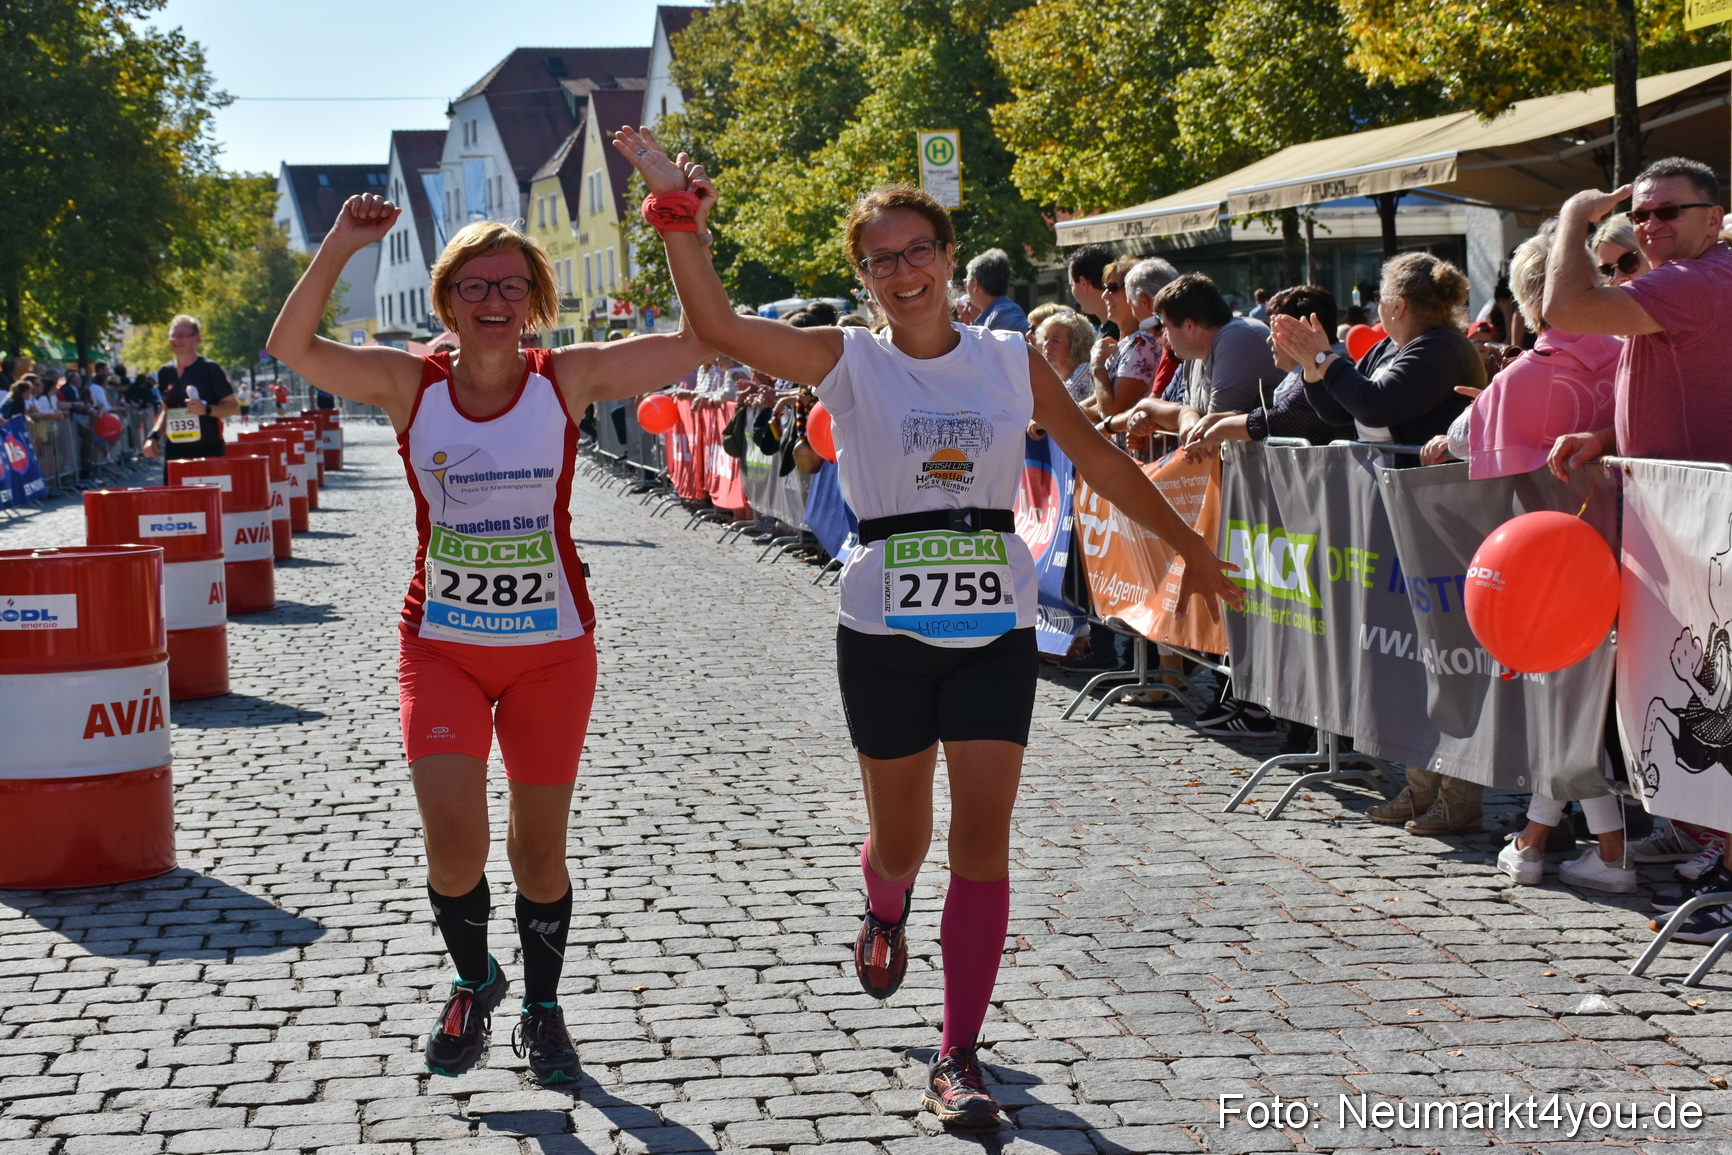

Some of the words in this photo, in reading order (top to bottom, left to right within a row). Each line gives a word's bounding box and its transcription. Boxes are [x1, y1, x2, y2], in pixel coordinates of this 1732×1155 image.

[932, 143, 947, 159] H
[170, 419, 195, 431] 1339
[924, 462, 951, 471] FINISH
[953, 462, 972, 471] LINE
[448, 469, 532, 484] Physiotherapie
[533, 468, 554, 479] Wild
[916, 472, 975, 484] Herbstlauf
[490, 483, 542, 491] Krankengymnastik
[456, 519, 511, 534] machen
[513, 516, 533, 530] Sie
[536, 514, 549, 529] fit!
[438, 534, 545, 563] BOCK
[896, 534, 1000, 562] BOCK
[440, 569, 542, 607] 2282
[899, 571, 1001, 608] 2759
[447, 611, 536, 631] CLAUDIA
[918, 619, 978, 637] MARION
